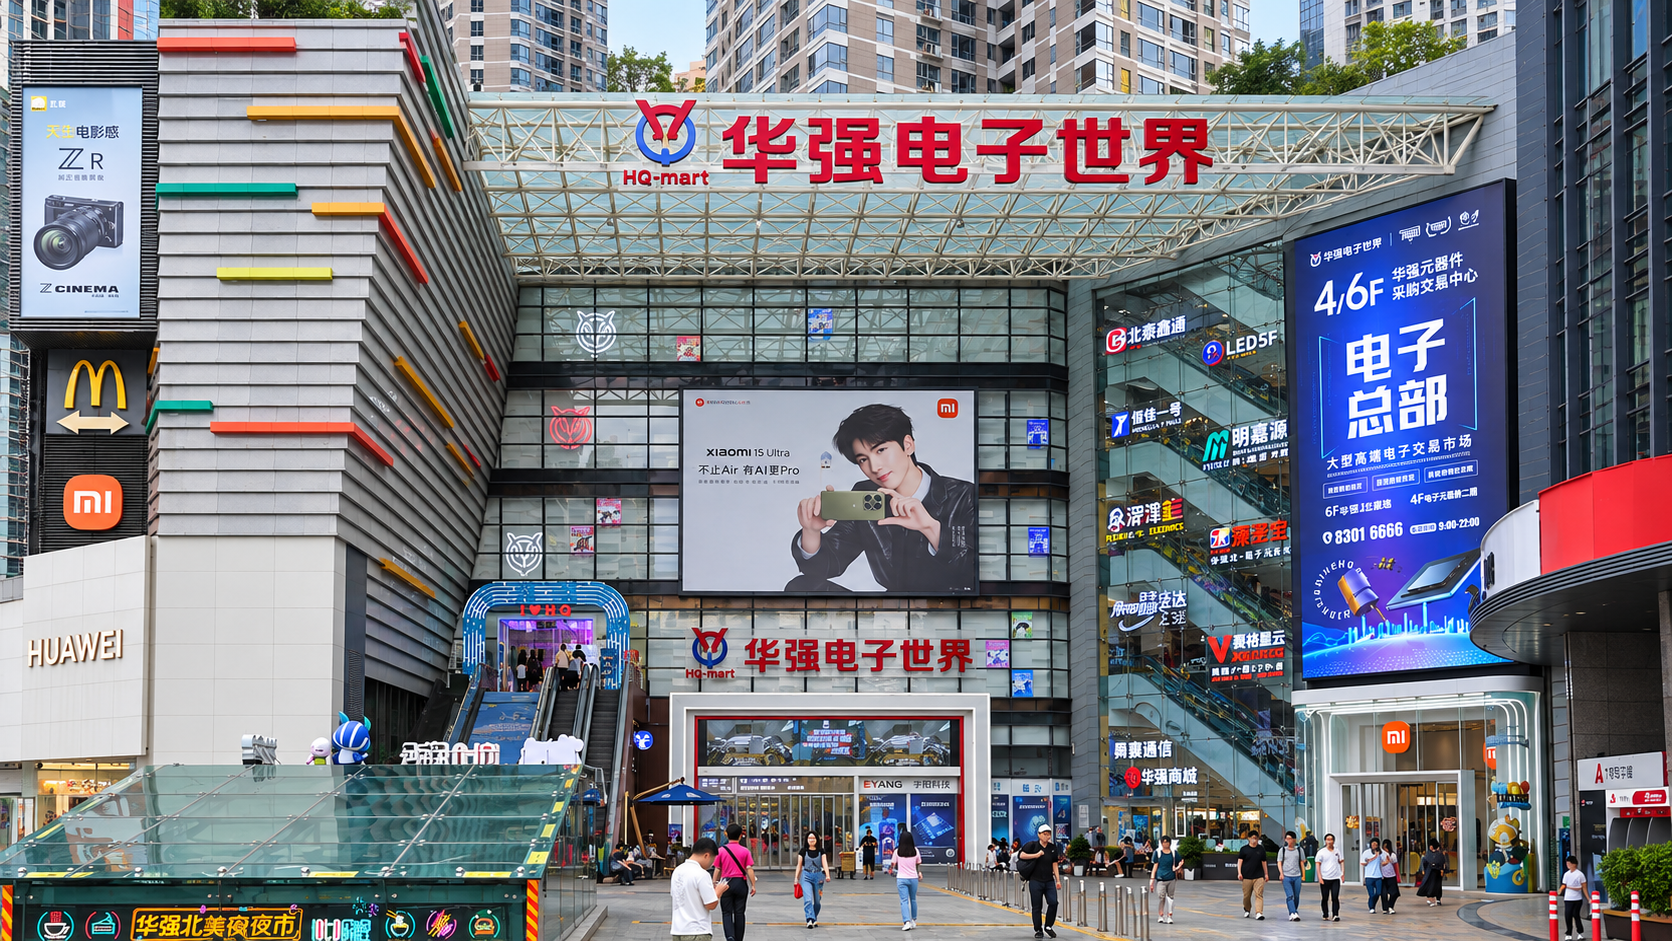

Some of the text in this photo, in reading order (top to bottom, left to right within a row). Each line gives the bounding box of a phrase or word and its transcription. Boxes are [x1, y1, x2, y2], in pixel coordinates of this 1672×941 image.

[46, 124, 120, 139] 天生电影感
[90, 152, 104, 170] R
[722, 115, 1214, 185] 华强电子世界
[623, 169, 710, 187] HQ-mart
[1391, 251, 1464, 283] 华强元器件
[54, 284, 119, 294] CINEMA
[1314, 272, 1385, 316] 4/6F
[1226, 329, 1278, 356] LED5F
[1346, 318, 1446, 383] 电子
[1348, 373, 1448, 440] 总部
[706, 448, 752, 457] xiaomi
[766, 448, 790, 458] Ultra
[1326, 433, 1472, 471] 大型高端电子交易市场
[698, 464, 800, 476] 不止Air 有AI更Pro
[1334, 526, 1366, 545] 8301
[1369, 521, 1404, 541] 6666
[1438, 516, 1480, 531] 9:00-22:00
[28, 628, 124, 667] HUAWEI
[744, 638, 974, 673] 华强电子世界
[685, 668, 736, 679] HQ-mart
[863, 780, 903, 789] EYANG
